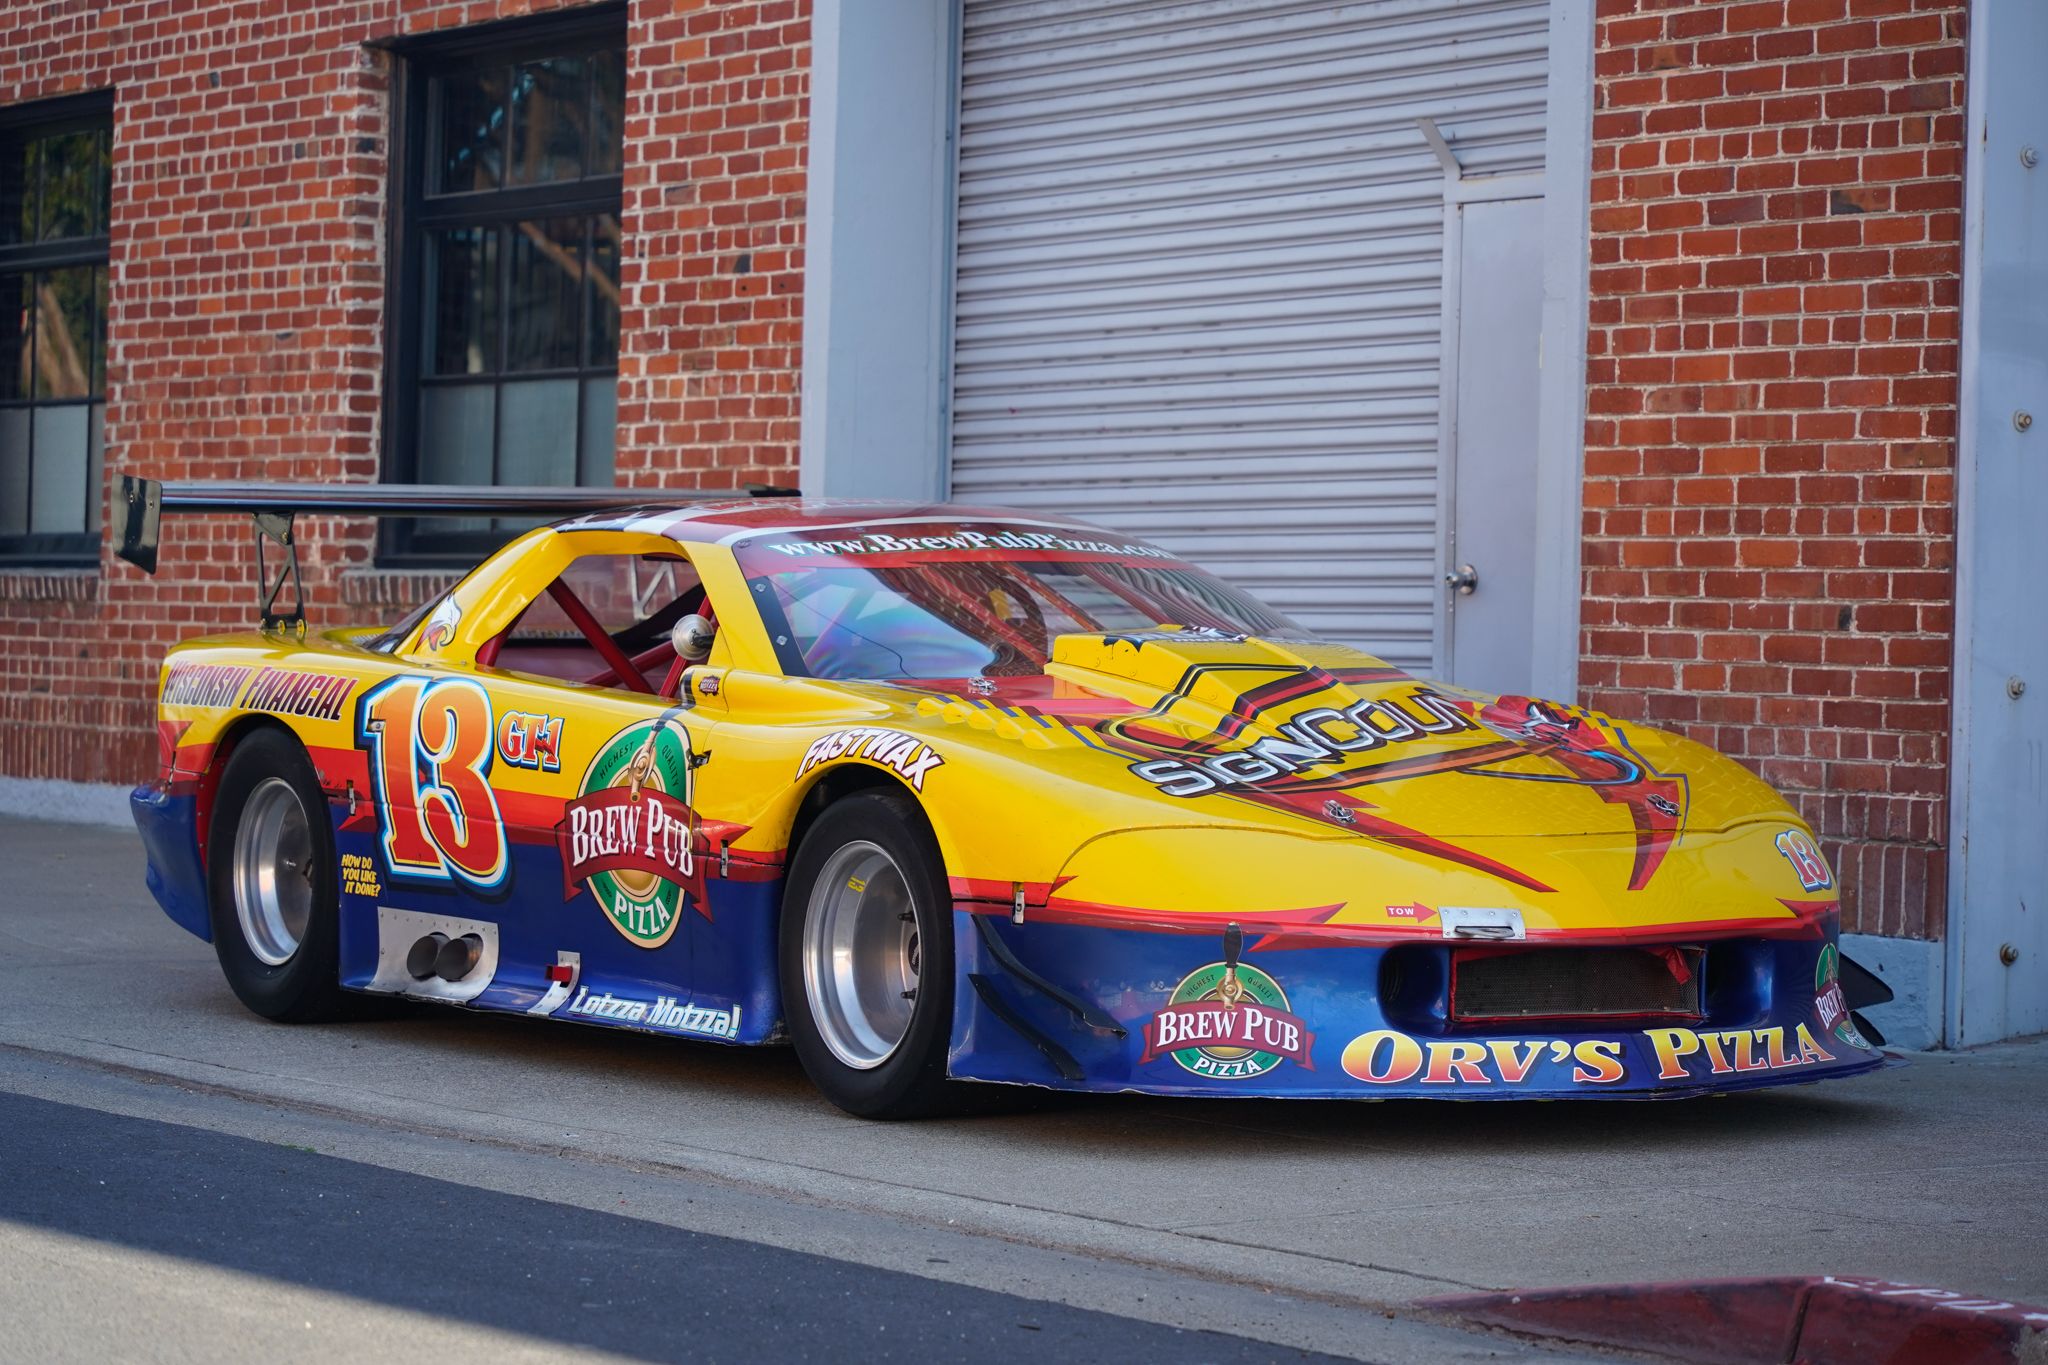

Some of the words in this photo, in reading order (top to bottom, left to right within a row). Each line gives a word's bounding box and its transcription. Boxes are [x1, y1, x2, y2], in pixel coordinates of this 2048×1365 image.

[161, 660, 253, 708] WISCONSIN
[238, 665, 360, 722] FINANCIAL
[362, 674, 510, 888] 13
[600, 741, 635, 780] HIGHEST
[661, 744, 680, 788] QUALITY
[794, 728, 945, 793] FASTWAX
[570, 805, 641, 866] BREW
[645, 798, 694, 878] PUB
[1776, 829, 1832, 893] 13
[341, 854, 361, 868] HOW
[361, 856, 373, 870] DO
[343, 867, 360, 881] YOU
[361, 869, 377, 883] LIKE
[345, 881, 355, 894] IT
[355, 881, 381, 897] DONE?
[1388, 907, 1414, 915] TOW
[613, 890, 671, 935] PIZZA
[1186, 974, 1215, 997] HIGHEST
[566, 985, 648, 1023] Lotzza
[645, 995, 742, 1041] Motzza!
[1156, 1010, 1238, 1047] BREW
[1242, 1007, 1299, 1052] PUB
[1193, 1057, 1263, 1076] PIZZA
[1341, 1030, 1624, 1083] ORV'S
[1643, 1022, 1836, 1080] PIZZA
